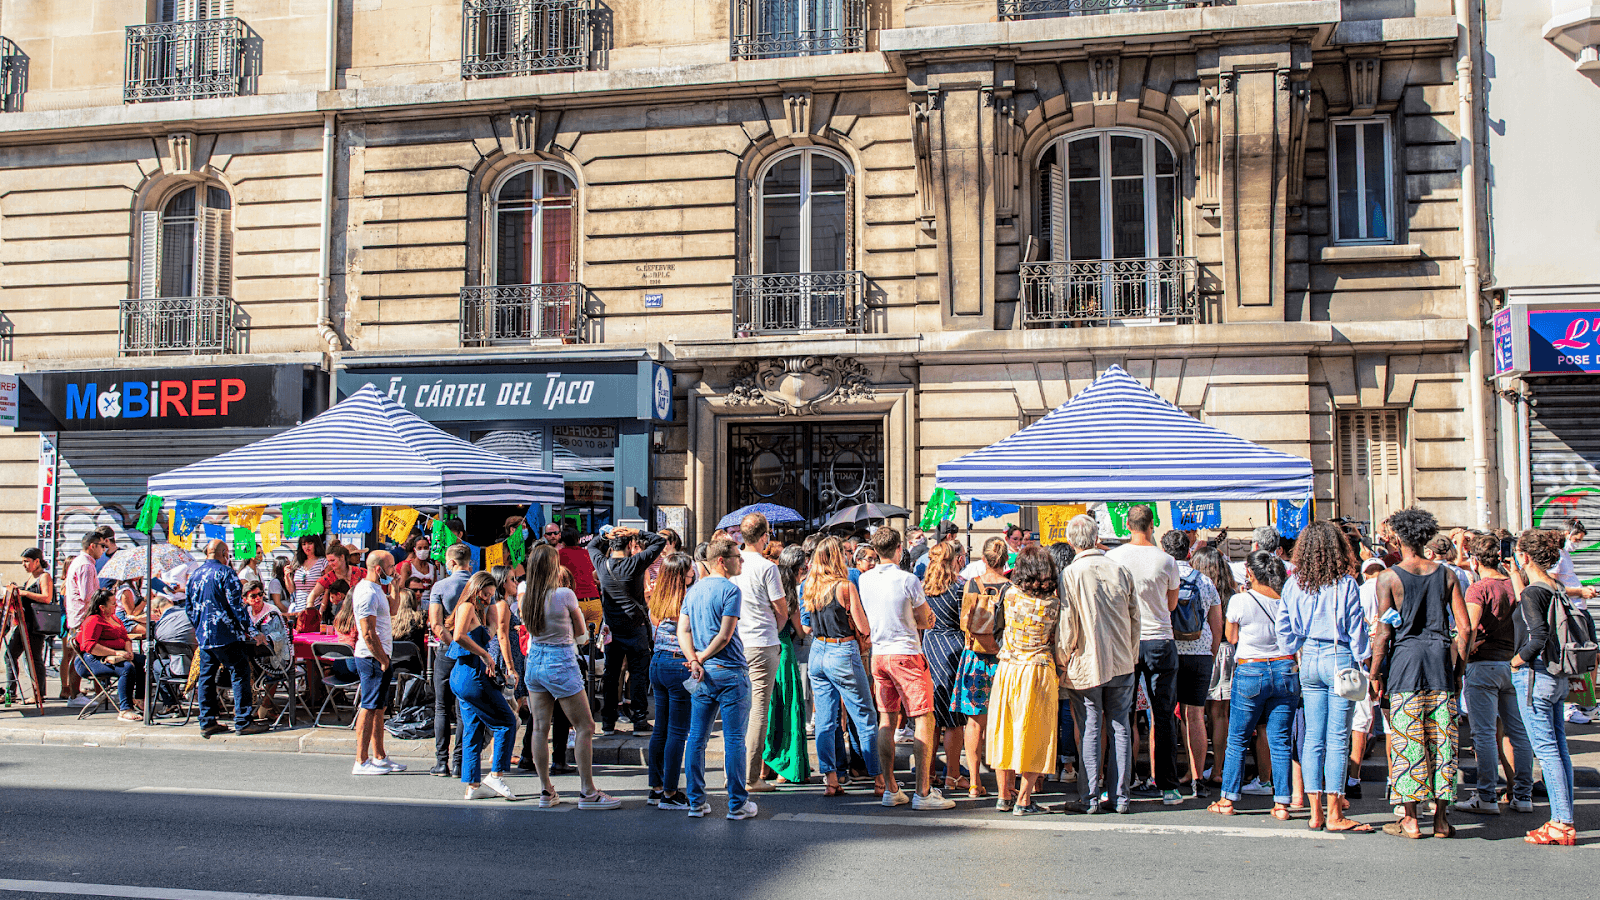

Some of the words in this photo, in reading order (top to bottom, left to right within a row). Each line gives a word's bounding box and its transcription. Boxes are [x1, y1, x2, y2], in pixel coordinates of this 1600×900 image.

[646, 296, 661, 306] 227
[1558, 355, 1590, 365] POSE
[414, 379, 487, 407] CÁRTEL
[496, 382, 532, 406] DEL
[543, 372, 595, 410] TACO
